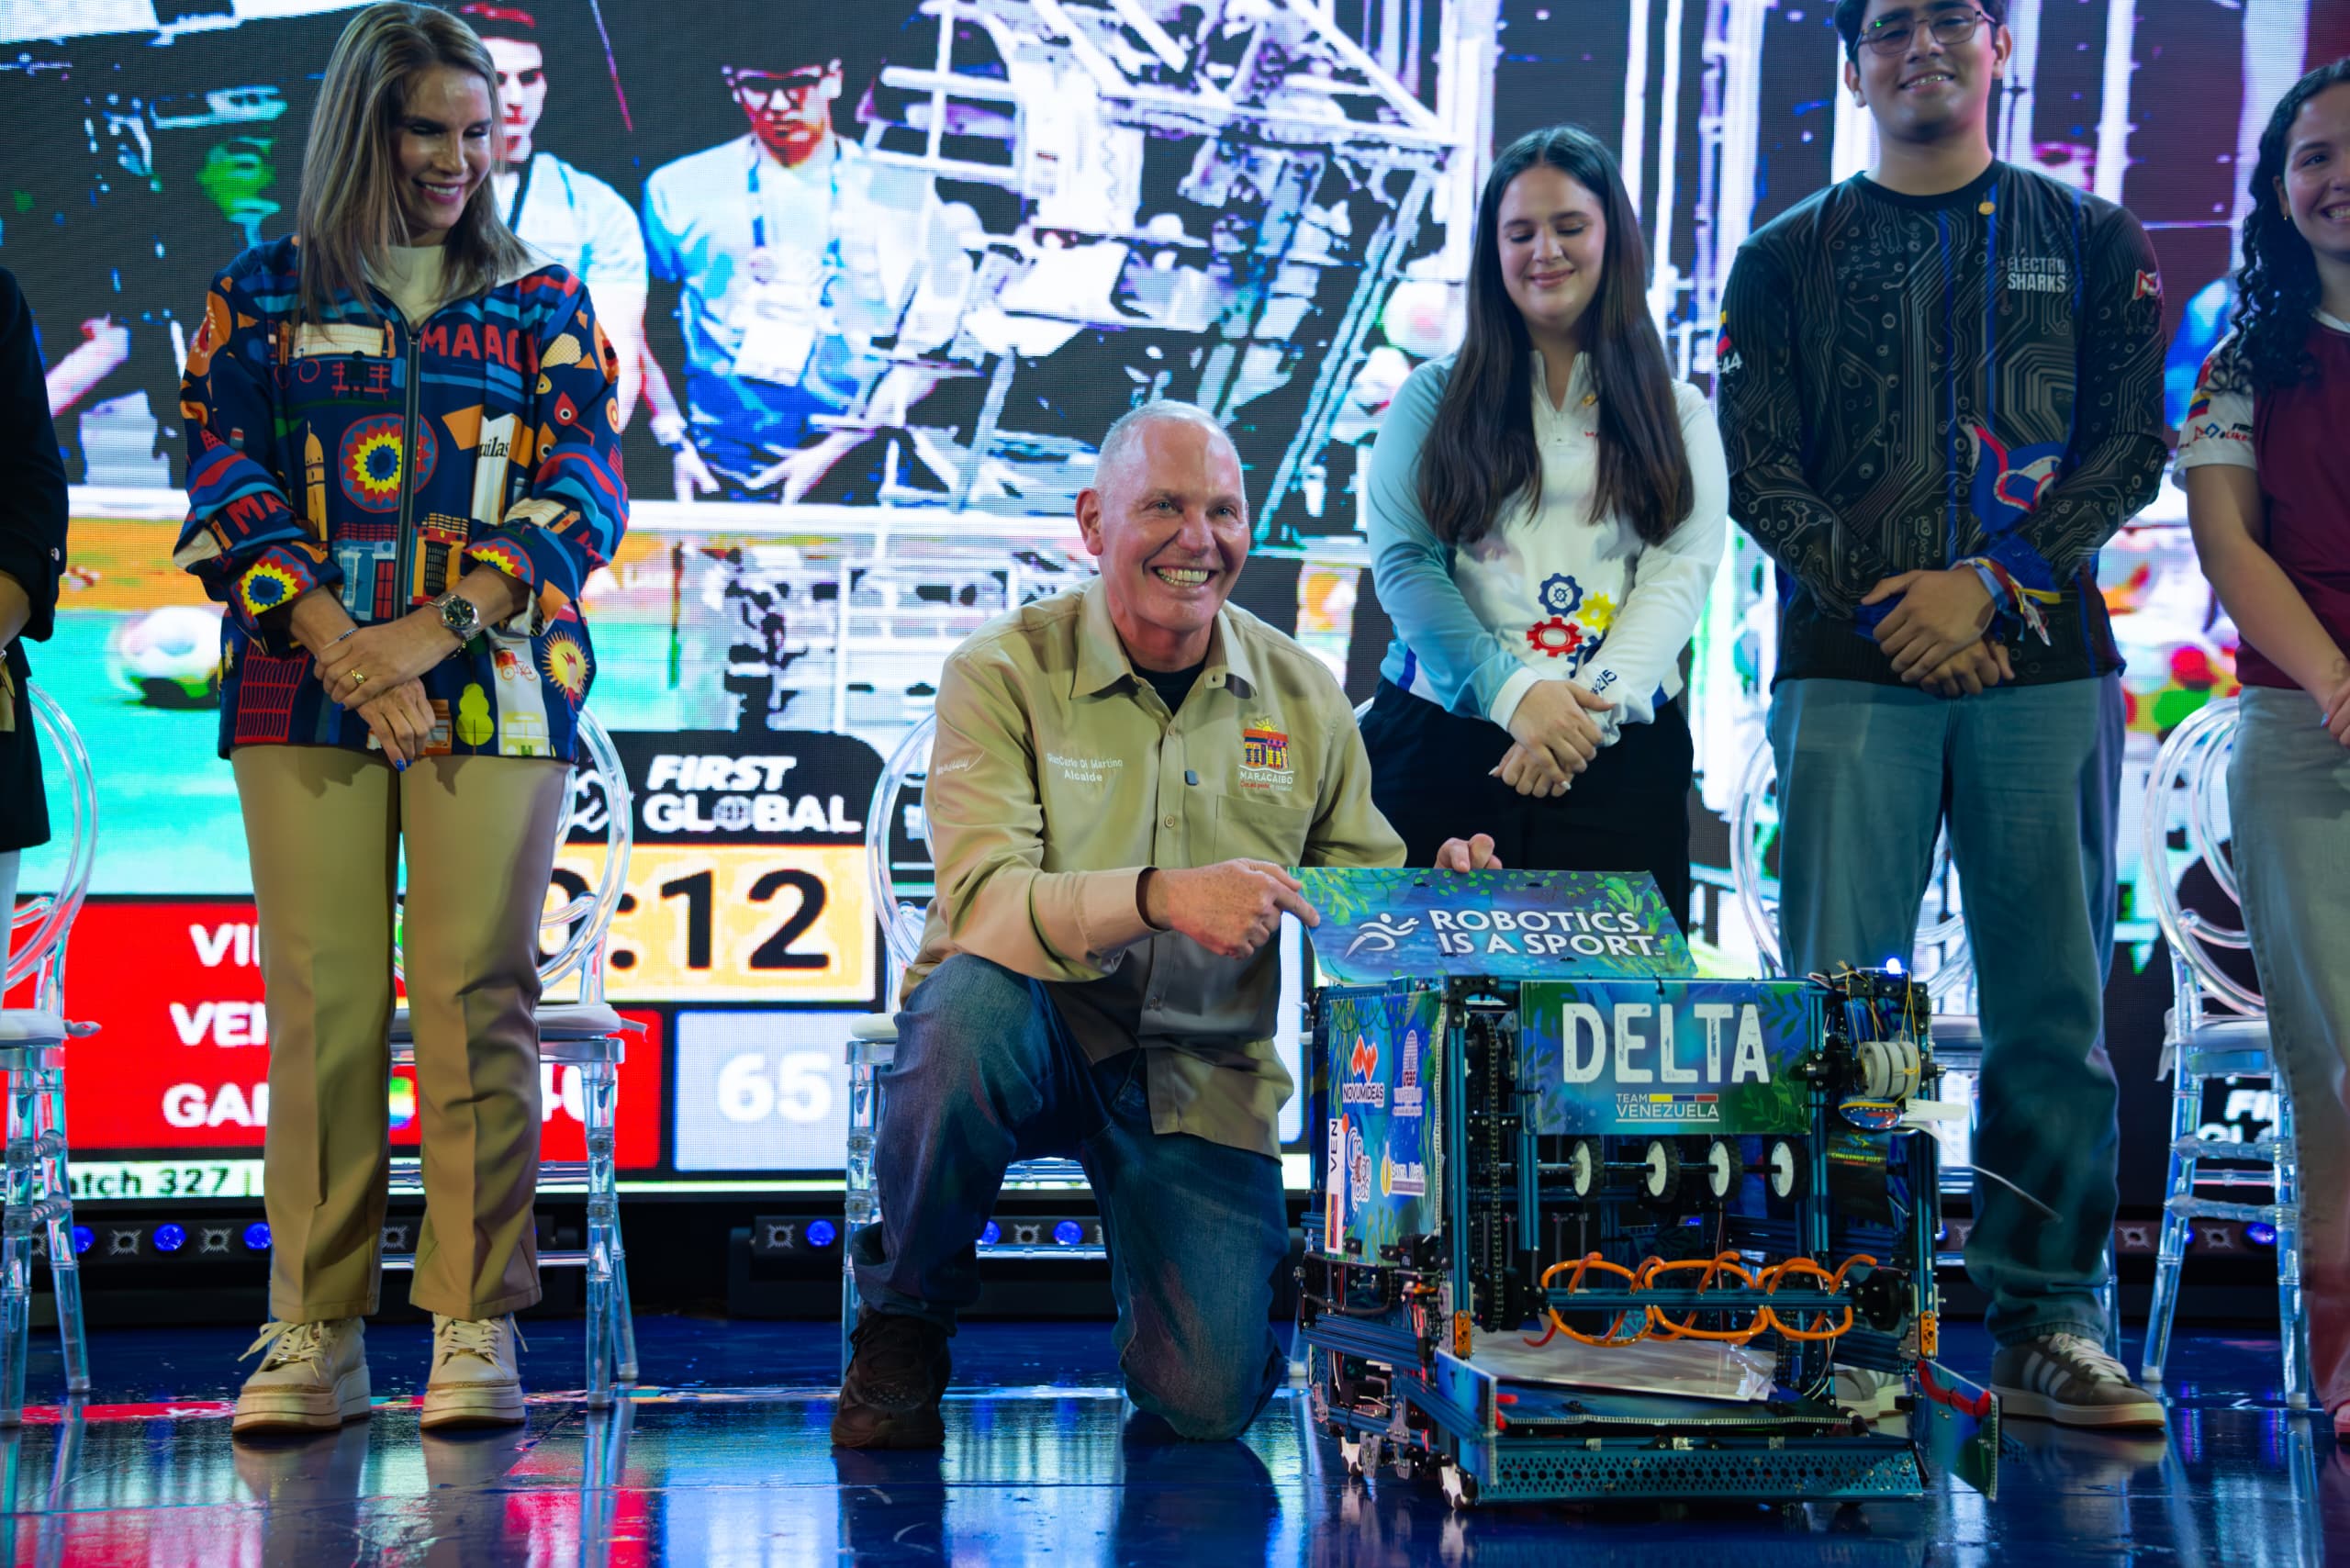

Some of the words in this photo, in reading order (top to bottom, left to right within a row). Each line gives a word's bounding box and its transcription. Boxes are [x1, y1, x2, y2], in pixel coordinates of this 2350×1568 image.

[2008, 273, 2066, 293] SHARKS
[646, 755, 797, 790] FIRST
[1064, 770, 1102, 782] Alcalde
[1240, 772, 1293, 785] MARACAIBO
[643, 793, 862, 833] GLOBAL
[1428, 910, 1640, 933] ROBOTICS
[1438, 933, 1474, 954] IS
[1487, 934, 1517, 954] A
[1524, 934, 1654, 956] SPORT
[1562, 1002, 1770, 1083] DELTA
[720, 1053, 832, 1124] 65
[1343, 1085, 1383, 1101] NOVUMIDEAS
[1616, 1093, 1648, 1103] TEAM
[1617, 1103, 1718, 1117] VENEZUELA
[159, 1168, 229, 1194] 327
